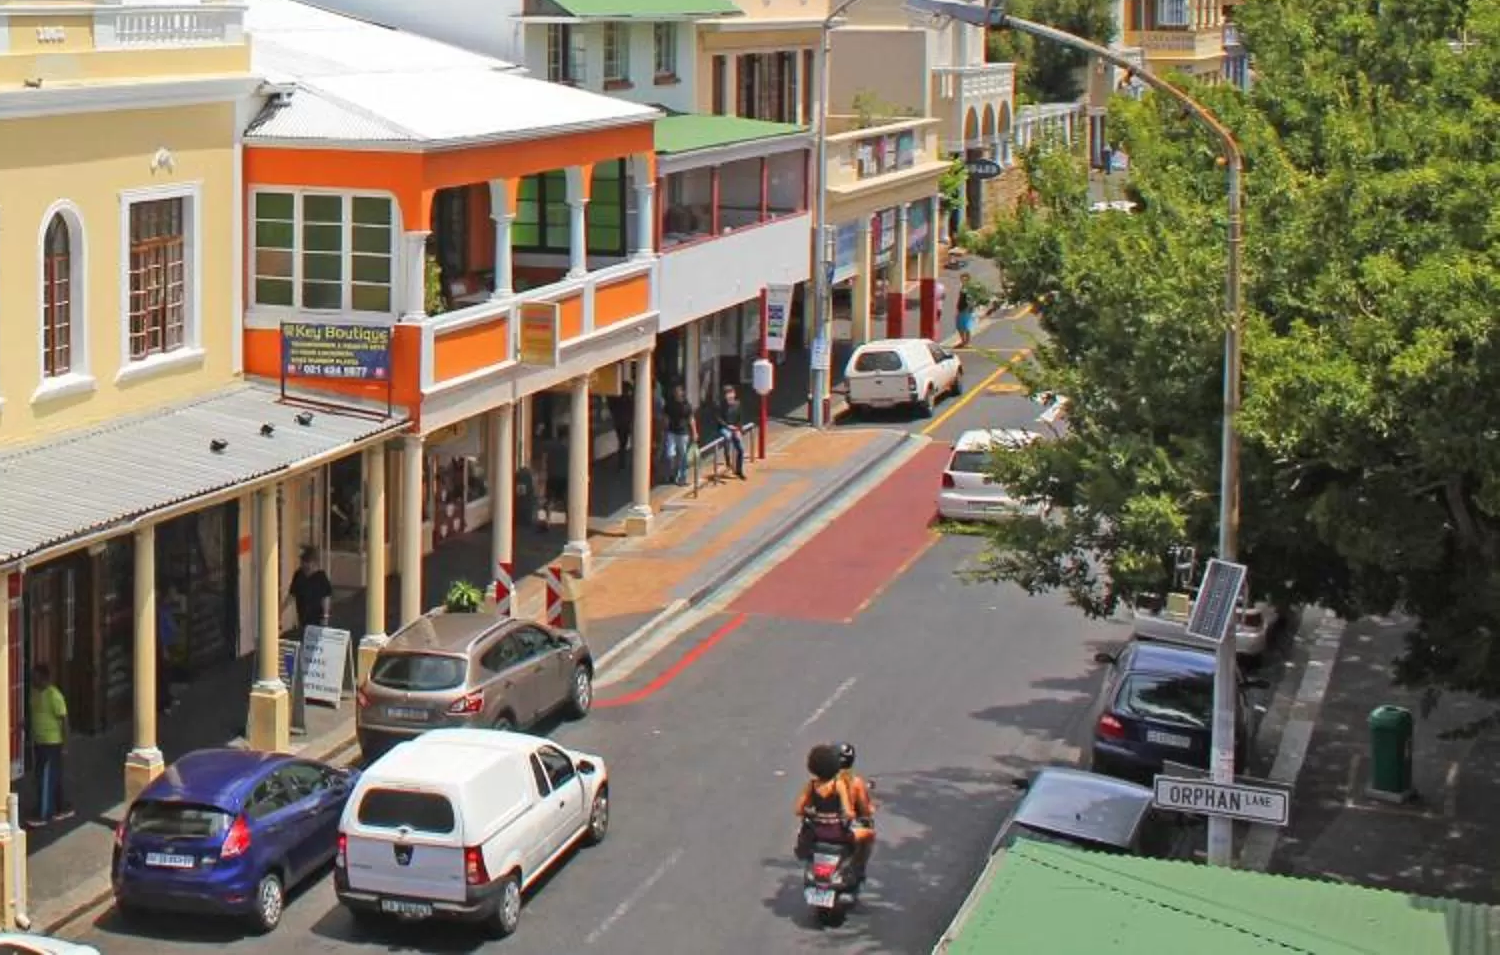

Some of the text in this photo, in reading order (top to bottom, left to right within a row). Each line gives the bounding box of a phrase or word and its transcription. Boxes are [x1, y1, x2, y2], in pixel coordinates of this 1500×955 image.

[295, 325, 321, 340] Key
[325, 326, 388, 343] Boutique
[1170, 785, 1273, 811] ORPHAN LANE
